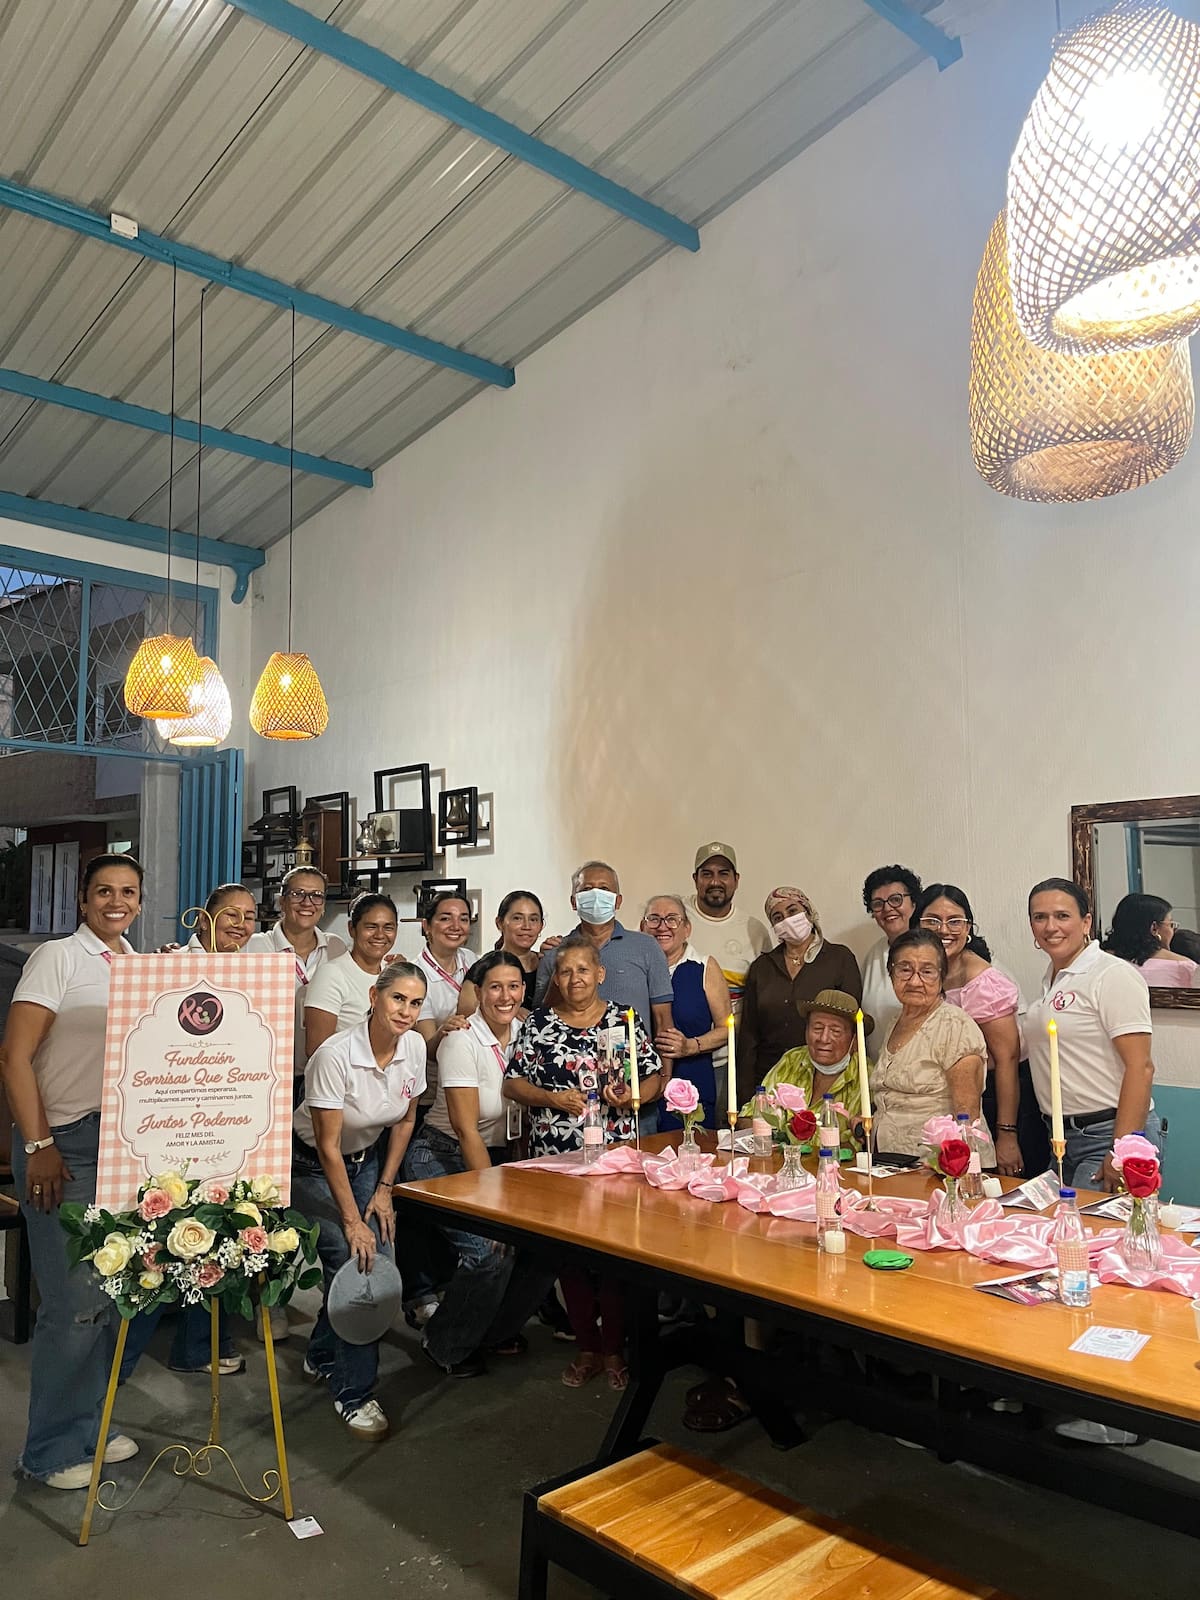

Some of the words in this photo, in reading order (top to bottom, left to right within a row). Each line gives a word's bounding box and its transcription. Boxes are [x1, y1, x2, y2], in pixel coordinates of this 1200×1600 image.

[164, 1050, 236, 1068] Fundación
[132, 1070, 191, 1088] Sonrisas
[193, 1067, 223, 1087] Que
[226, 1067, 270, 1084] Sanan
[155, 1088, 168, 1096] Aquí
[137, 1113, 187, 1135] Juntos
[190, 1111, 252, 1129] Podemos
[198, 1138, 225, 1146] AMISTAD
